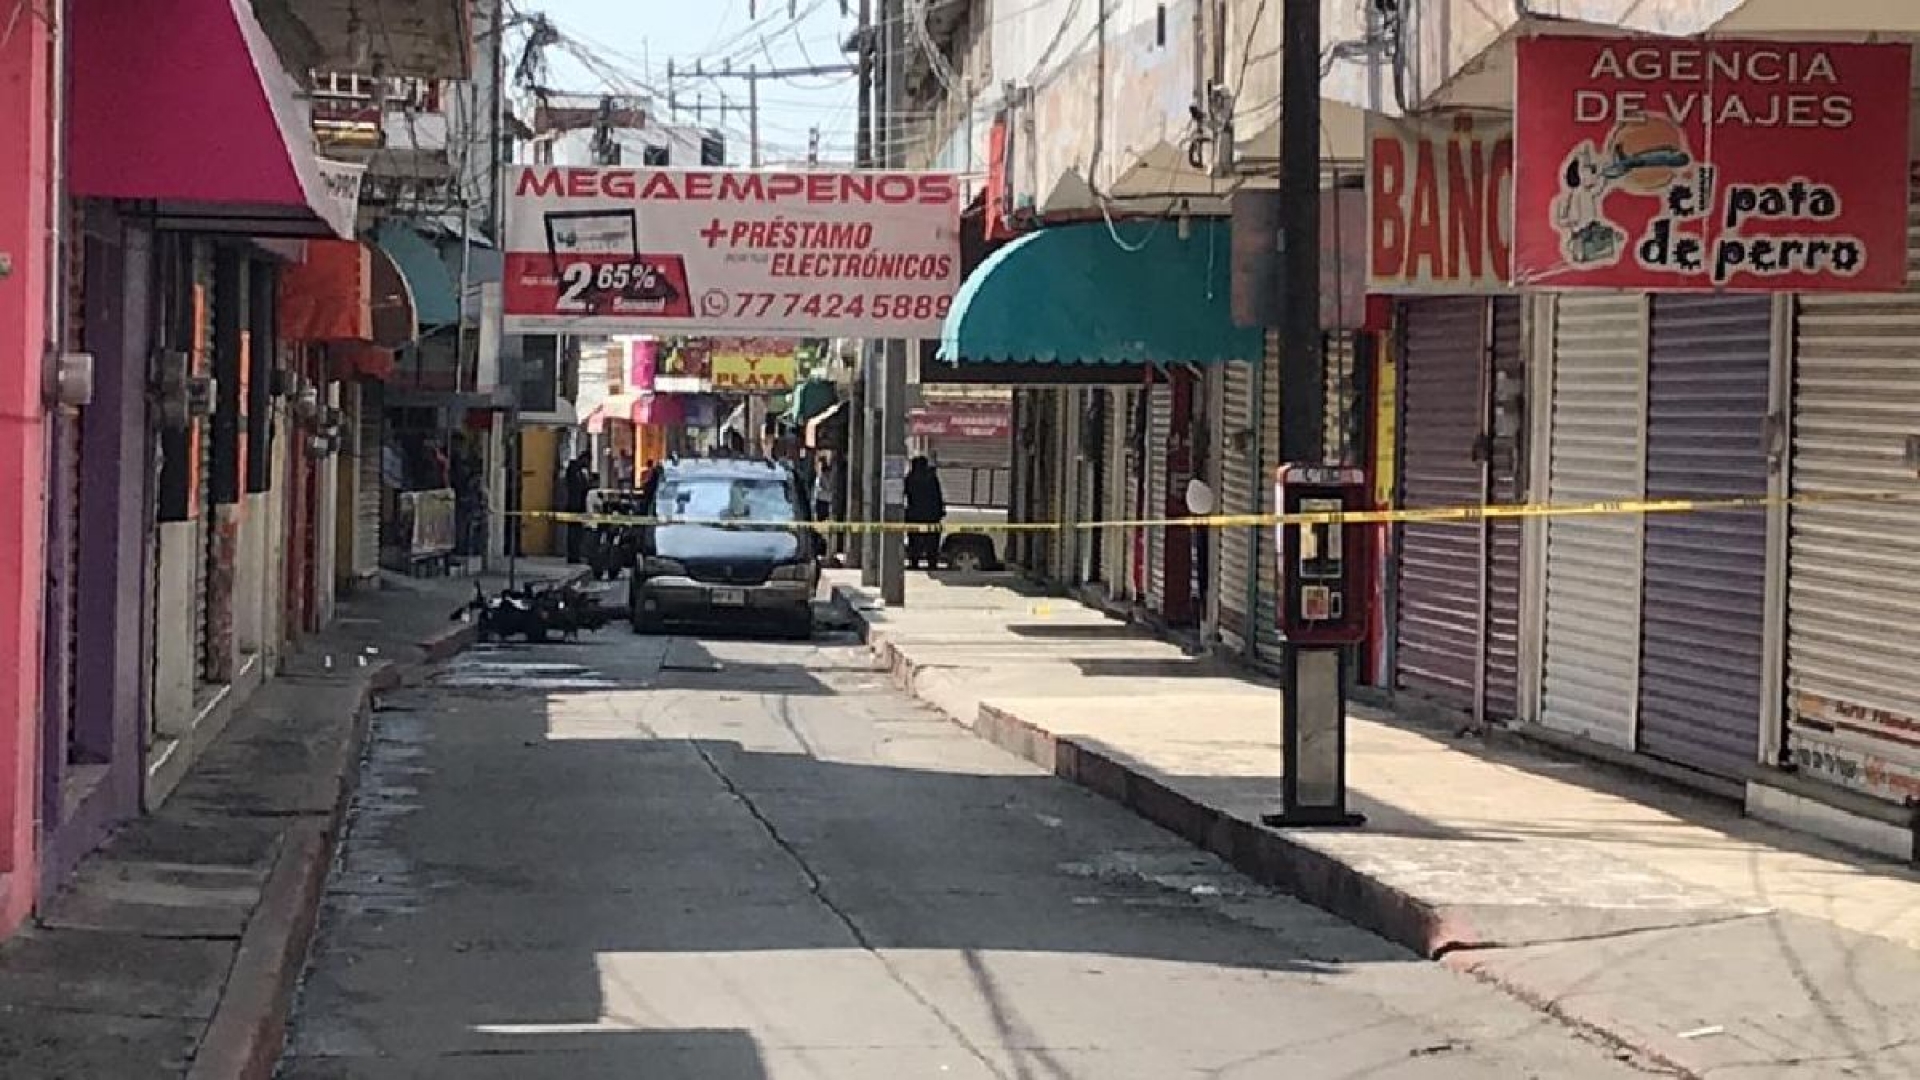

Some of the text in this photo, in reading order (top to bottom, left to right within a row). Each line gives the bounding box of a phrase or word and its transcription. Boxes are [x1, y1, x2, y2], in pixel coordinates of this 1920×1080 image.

[1590, 47, 1838, 83] AGENCIA
[1574, 90, 1852, 127] DE VIAJES
[1669, 167, 1835, 228] el pata
[769, 248, 952, 280] ELECTRÓNICOS
[1640, 219, 1859, 281] de perro
[717, 372, 787, 385] PLATA
